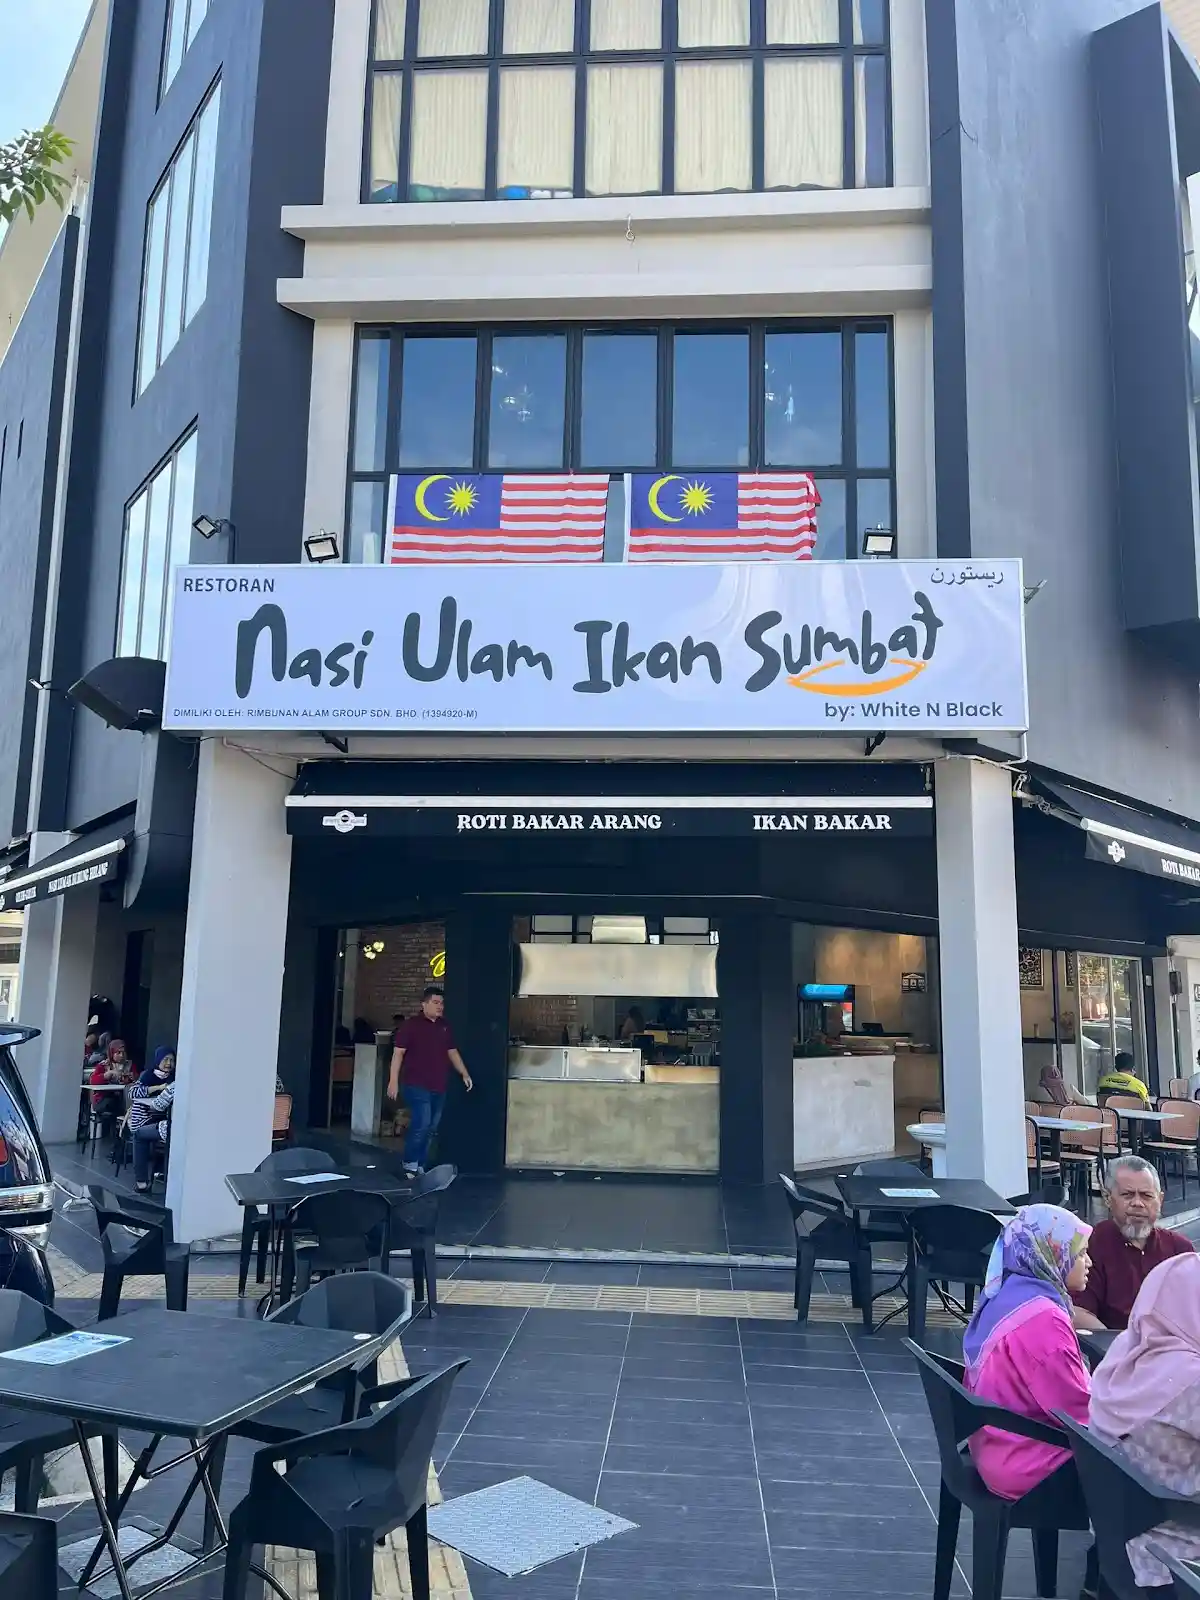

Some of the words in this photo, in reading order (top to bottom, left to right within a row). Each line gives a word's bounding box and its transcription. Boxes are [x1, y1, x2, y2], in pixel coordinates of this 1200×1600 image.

[183, 577, 275, 593] RESTORAN
[930, 566, 1004, 588] ريستورن
[402, 595, 553, 683] Ulam
[572, 620, 722, 693] Ikan
[744, 590, 944, 693] Sumbat
[173, 708, 212, 717] DIMILIKI
[214, 708, 244, 717] OLEH:
[247, 708, 299, 717] RIMBUNAN
[301, 709, 330, 717] ALAM
[331, 709, 368, 718] GROUP
[369, 709, 393, 718] SDN.
[422, 709, 478, 719] (1394920-M)
[824, 702, 855, 722] by:
[860, 701, 921, 717] White
[926, 702, 940, 717] N
[946, 701, 1004, 717] Black
[456, 814, 507, 830] ROTI
[511, 814, 585, 830] BAKAR
[588, 814, 663, 830] ARANG
[752, 814, 809, 830] IKAN
[813, 814, 893, 830] BAKAR
[1160, 858, 1180, 876] ROTI
